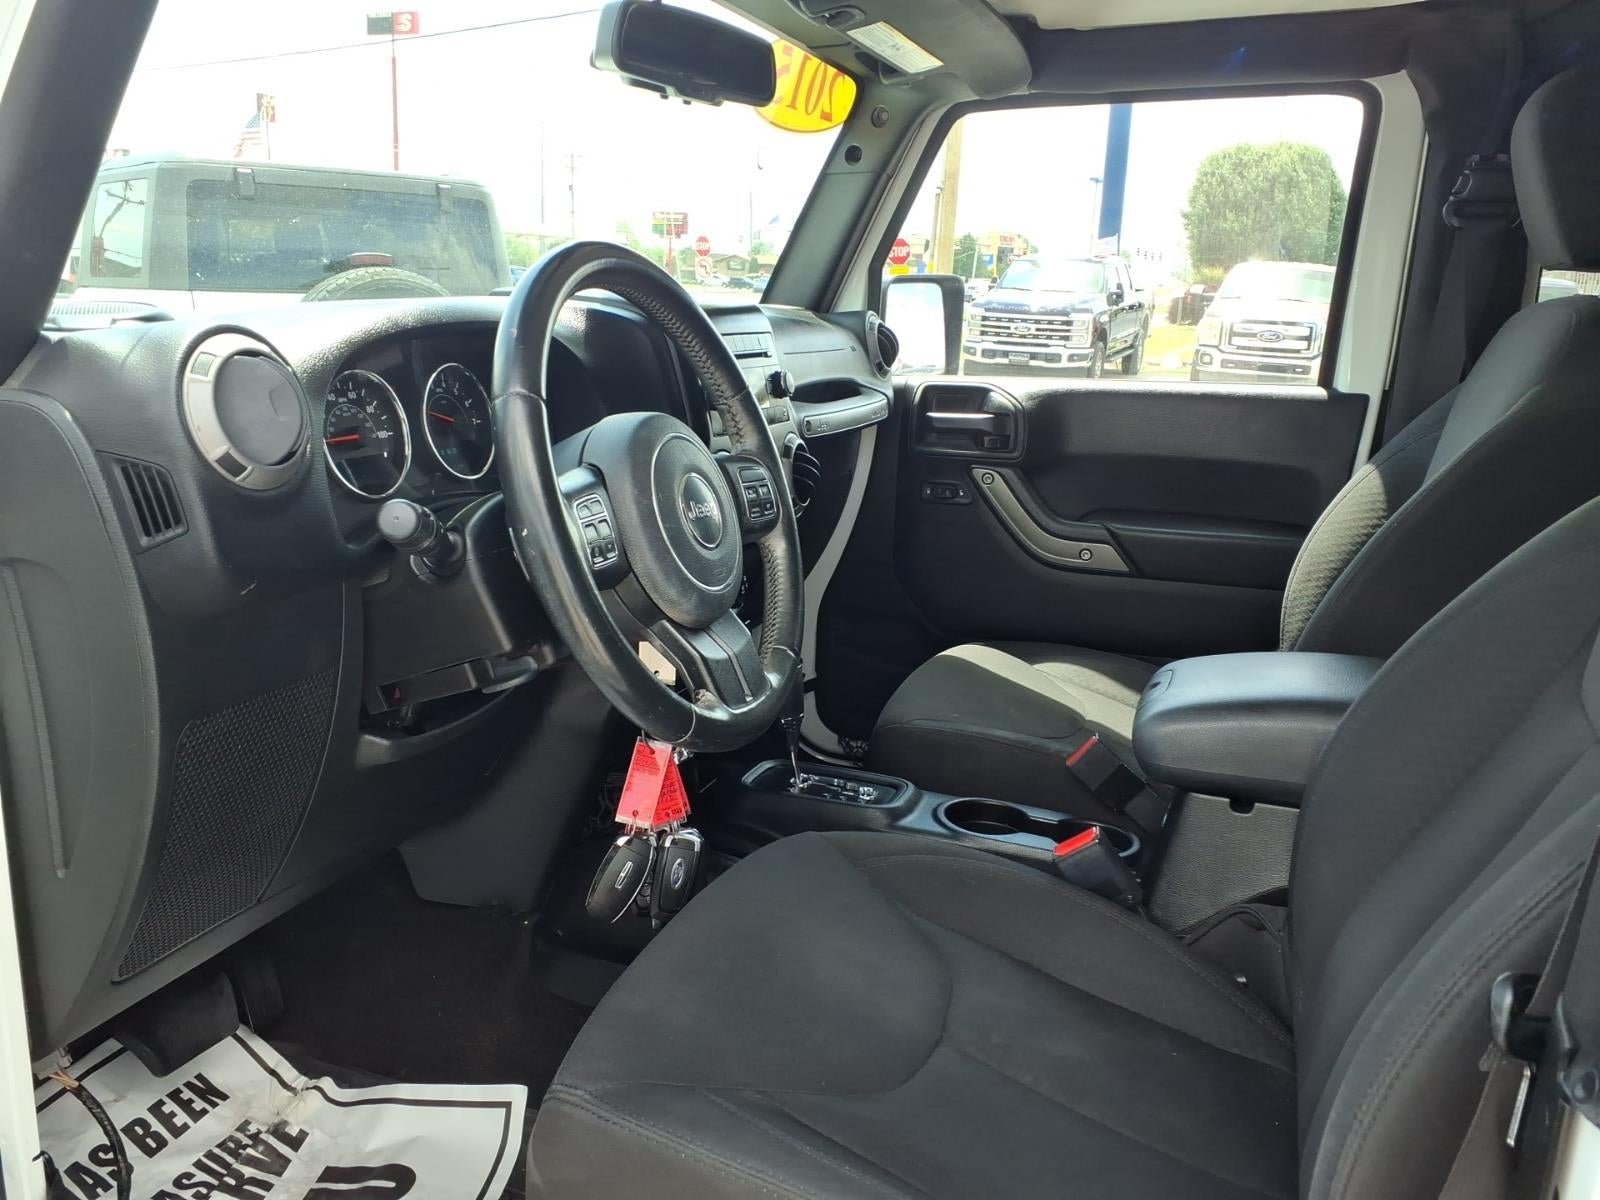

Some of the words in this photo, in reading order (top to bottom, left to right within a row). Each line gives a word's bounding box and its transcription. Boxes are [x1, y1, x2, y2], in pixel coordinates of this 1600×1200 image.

[696, 241, 710, 251] STOP
[889, 246, 910, 257] STOP
[376, 430, 388, 439] 100
[688, 500, 719, 521] Jeep
[120, 1072, 231, 1158] BEEN
